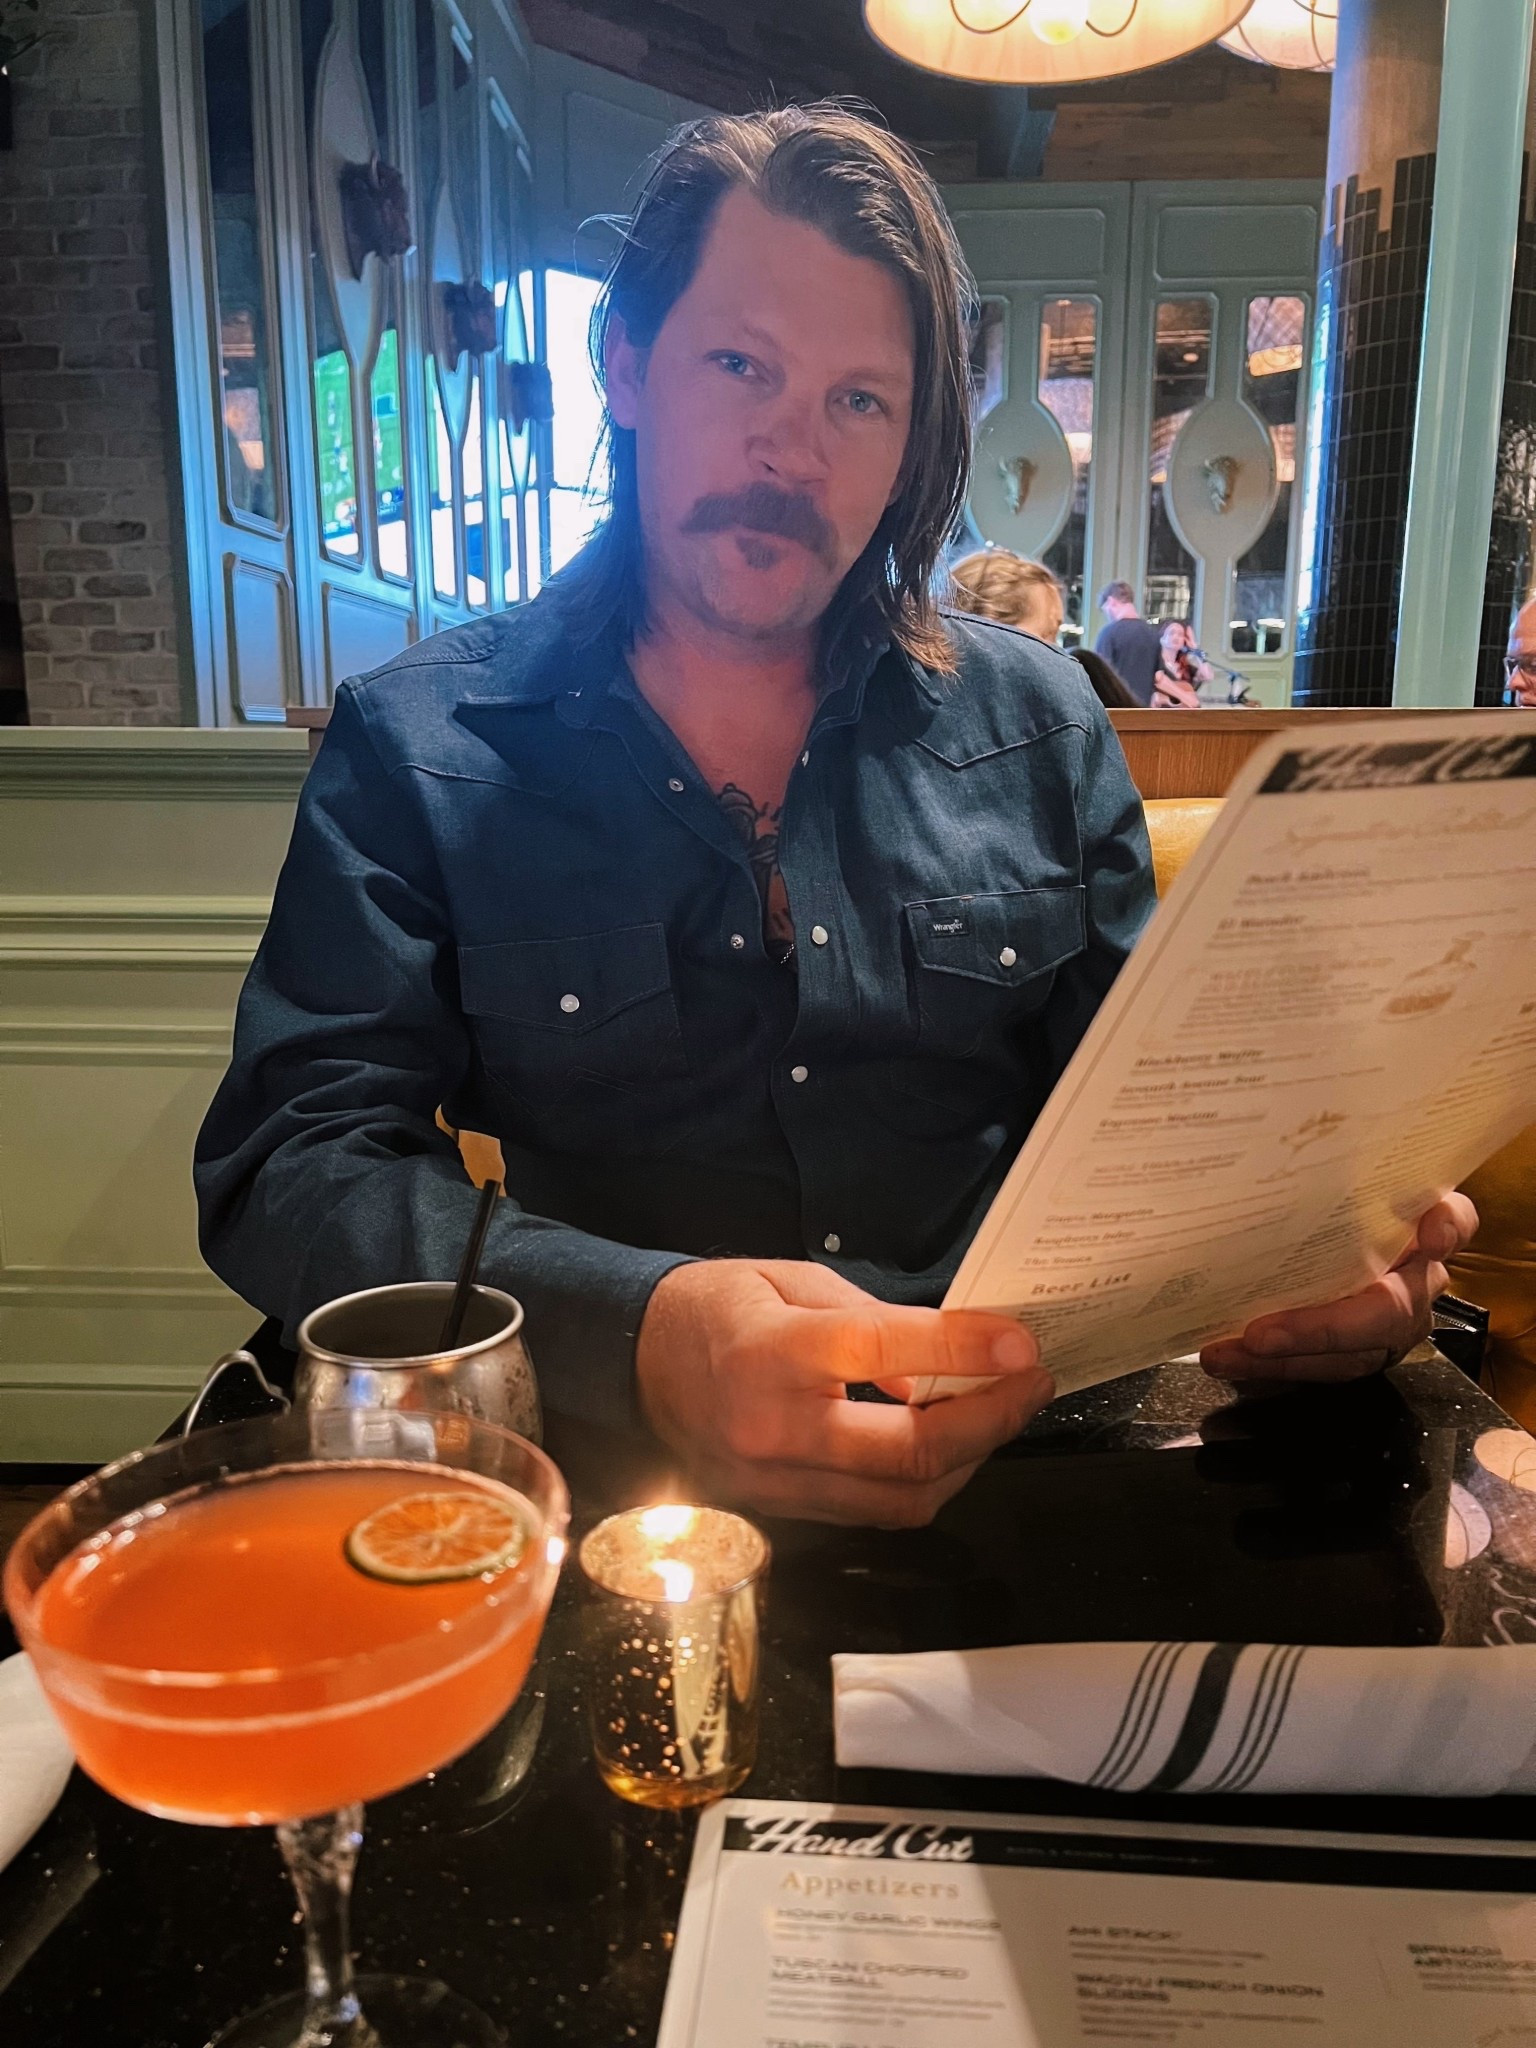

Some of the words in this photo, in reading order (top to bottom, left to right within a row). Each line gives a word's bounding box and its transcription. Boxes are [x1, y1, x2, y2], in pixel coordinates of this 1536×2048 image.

[932, 921, 964, 933] Wrangler
[1031, 1280, 1084, 1295] Beer
[1090, 1272, 1132, 1288] List
[744, 1815, 897, 1856] Hand
[893, 1823, 974, 1862] Cut
[779, 1871, 960, 1900] Appetizers
[777, 1907, 848, 1922] HONEY
[852, 1911, 928, 1928] GARLIC
[931, 1916, 1001, 1931] WINGS
[771, 1955, 858, 1972] TUSCAN
